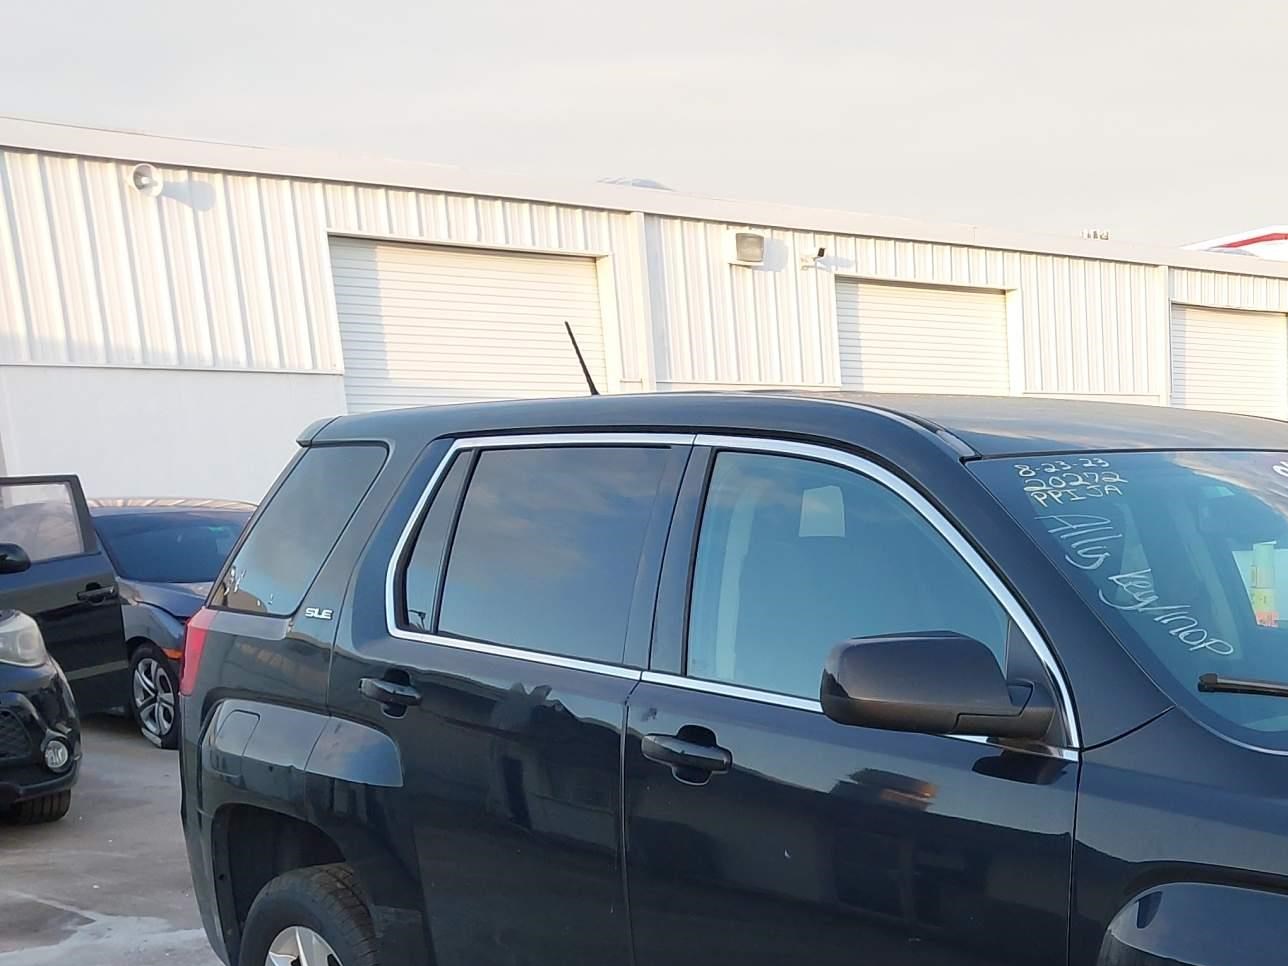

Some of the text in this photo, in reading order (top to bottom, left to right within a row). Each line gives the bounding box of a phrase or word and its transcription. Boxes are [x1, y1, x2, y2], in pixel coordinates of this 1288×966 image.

[1014, 457, 1110, 477] 8-23-23
[1023, 471, 1128, 492] 20272
[304, 606, 333, 620] SLE
